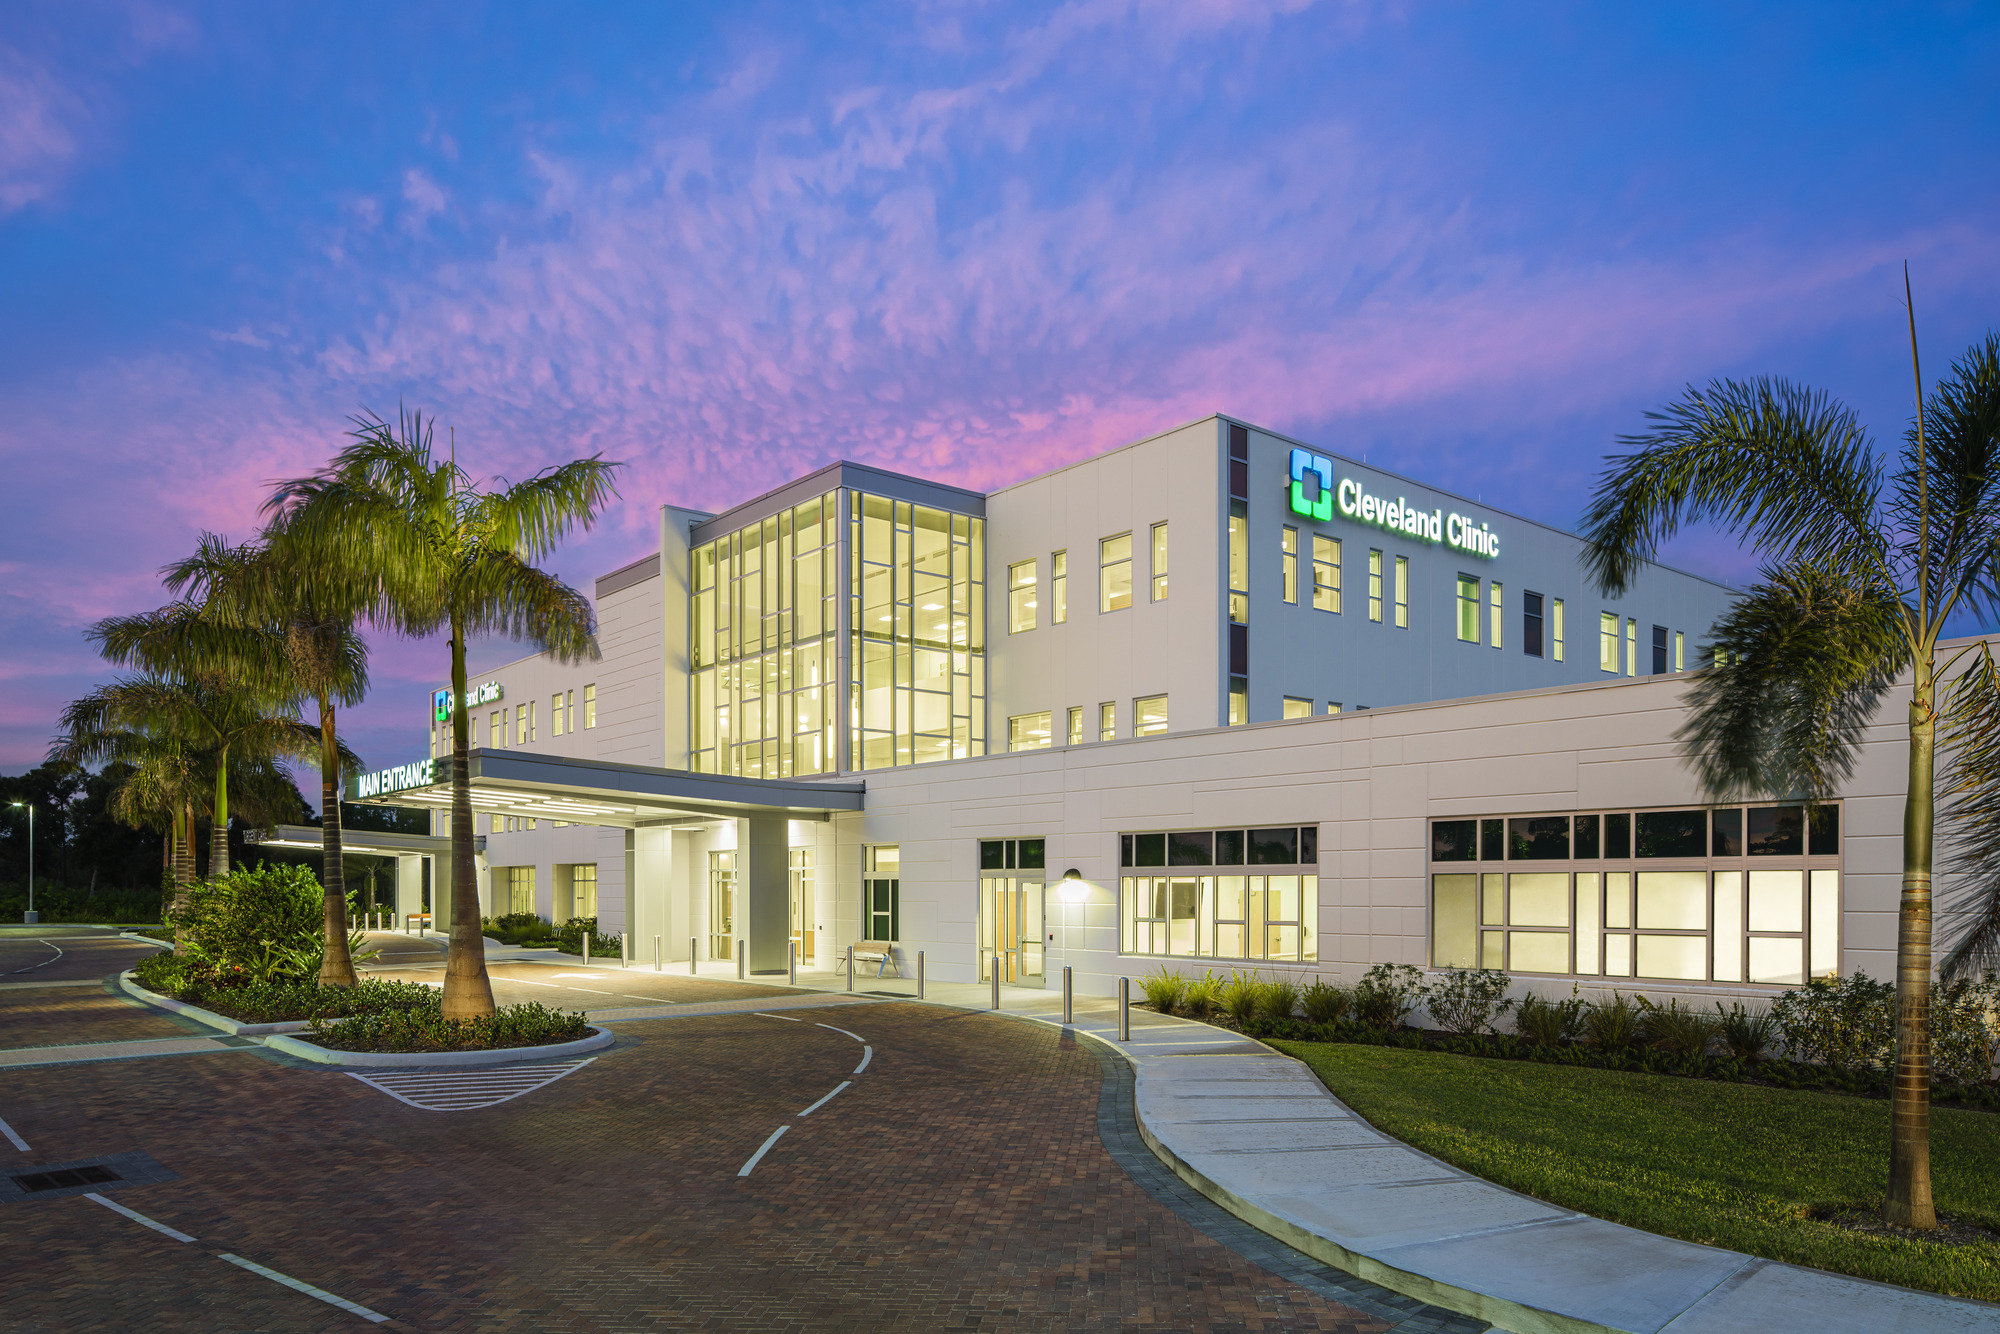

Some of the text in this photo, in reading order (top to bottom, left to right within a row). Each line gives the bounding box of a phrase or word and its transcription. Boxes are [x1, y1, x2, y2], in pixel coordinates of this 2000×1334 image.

[1338, 478, 1499, 558] Cleveland Clinic
[480, 680, 499, 703] Clinic
[359, 759, 433, 797] MAIN ENTRANCE
